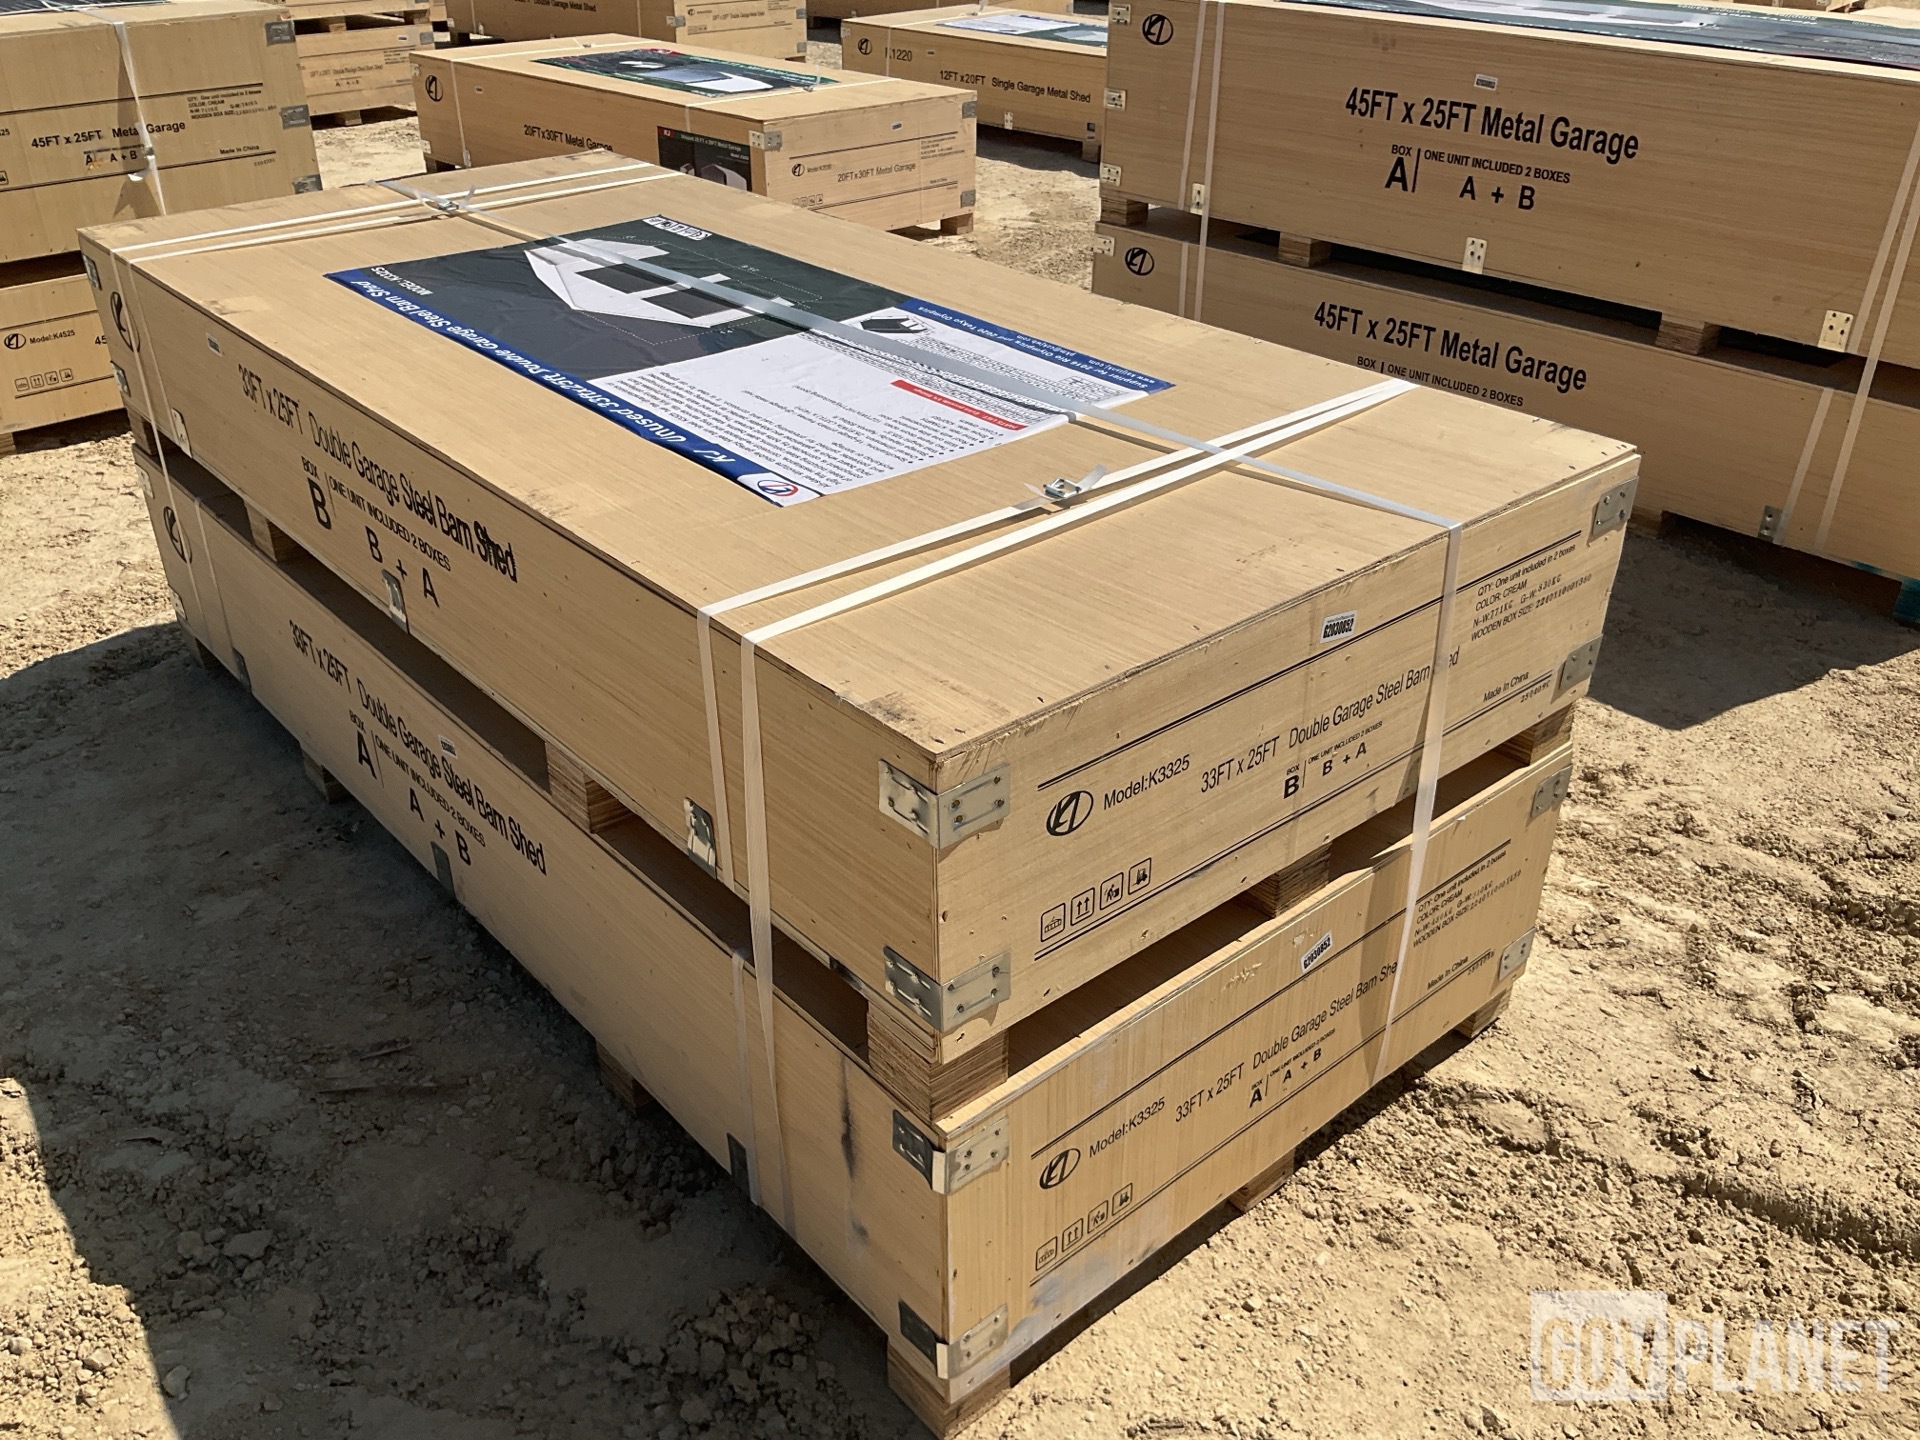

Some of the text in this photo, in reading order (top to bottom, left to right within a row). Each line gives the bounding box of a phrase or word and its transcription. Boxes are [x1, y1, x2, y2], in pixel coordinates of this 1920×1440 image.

[940, 70, 958, 82] 12FT
[991, 77, 1015, 90] Single
[1017, 81, 1045, 97] Garage
[1047, 86, 1068, 99] Metal
[1069, 89, 1091, 103] Shed
[31, 122, 186, 148] 45FT x 25FT Meta Garage
[565, 133, 585, 149] Metal
[1346, 87, 1639, 165] 45FT x 25FT Metal Garage
[85, 154, 93, 165] A
[110, 153, 118, 162] A
[130, 150, 138, 160] B
[876, 166, 893, 176] Metal
[894, 163, 916, 172] Garage
[1391, 144, 1571, 184] BOX ONE UNIT INCLUDED 2 BOXES
[1384, 156, 1408, 192] A
[1459, 176, 1535, 210] A + B
[345, 279, 394, 297] Shed
[378, 295, 422, 311] Barn
[392, 279, 435, 295] MODEL:
[406, 309, 455, 327] Steel
[912, 306, 957, 320] Olympics
[946, 318, 984, 329] Tokyo
[442, 324, 507, 350] Garage
[1007, 339, 1059, 356] Olympics
[1314, 301, 1587, 394] 45FT x 25FT Metal Garage
[487, 347, 553, 375] Double
[1049, 354, 1073, 362] Rio
[1104, 372, 1153, 388] Supplier
[1357, 356, 1524, 407] BOX ONE UNIT INCLUDED 2 BOXES
[605, 406, 691, 444] Unused
[689, 445, 737, 465] KJ
[237, 362, 518, 584] 33FT x 25FT Double Garage Steel Barn Shed
[300, 455, 451, 573] BOX ONE UNIT INCLUDED 2 BOXES
[306, 476, 334, 534] B
[364, 524, 439, 608] B + A
[1476, 581, 1493, 597] QTY:
[1494, 573, 1509, 589] One
[1509, 568, 1521, 582] unit
[1521, 556, 1547, 576] included
[1546, 552, 1554, 564] in
[1553, 551, 1558, 560] 2
[1474, 578, 1528, 612] COLOR: CREAM
[1470, 617, 1502, 642] WOODEN
[1502, 610, 1517, 626] BOX
[1482, 683, 1502, 702] Made
[1509, 668, 1530, 688] China
[1200, 659, 1432, 794] 33FT x 25FT Double Garage Steel Barn
[288, 616, 318, 667] 33FT
[314, 645, 326, 673] x
[322, 646, 354, 697] 25FT
[356, 676, 398, 740] Double
[396, 713, 443, 787] Garage
[440, 752, 475, 810] Steel
[473, 782, 509, 841] Barn
[506, 812, 547, 877] Shed
[350, 723, 377, 780] A
[1321, 739, 1368, 777] B + A
[348, 708, 486, 849] BOX ONE UNIT INCLUDED 2 BOXES
[1103, 753, 1190, 810] Model:K3325
[1282, 771, 1301, 800] B
[405, 782, 472, 868] A + B
[1174, 956, 1398, 1123] 33FT x 25FT Double Garage Steel Barn She
[1283, 1066, 1293, 1083] A
[1312, 1045, 1322, 1062] B
[1248, 1084, 1264, 1108] A
[1089, 1096, 1165, 1158] Model:K3325
